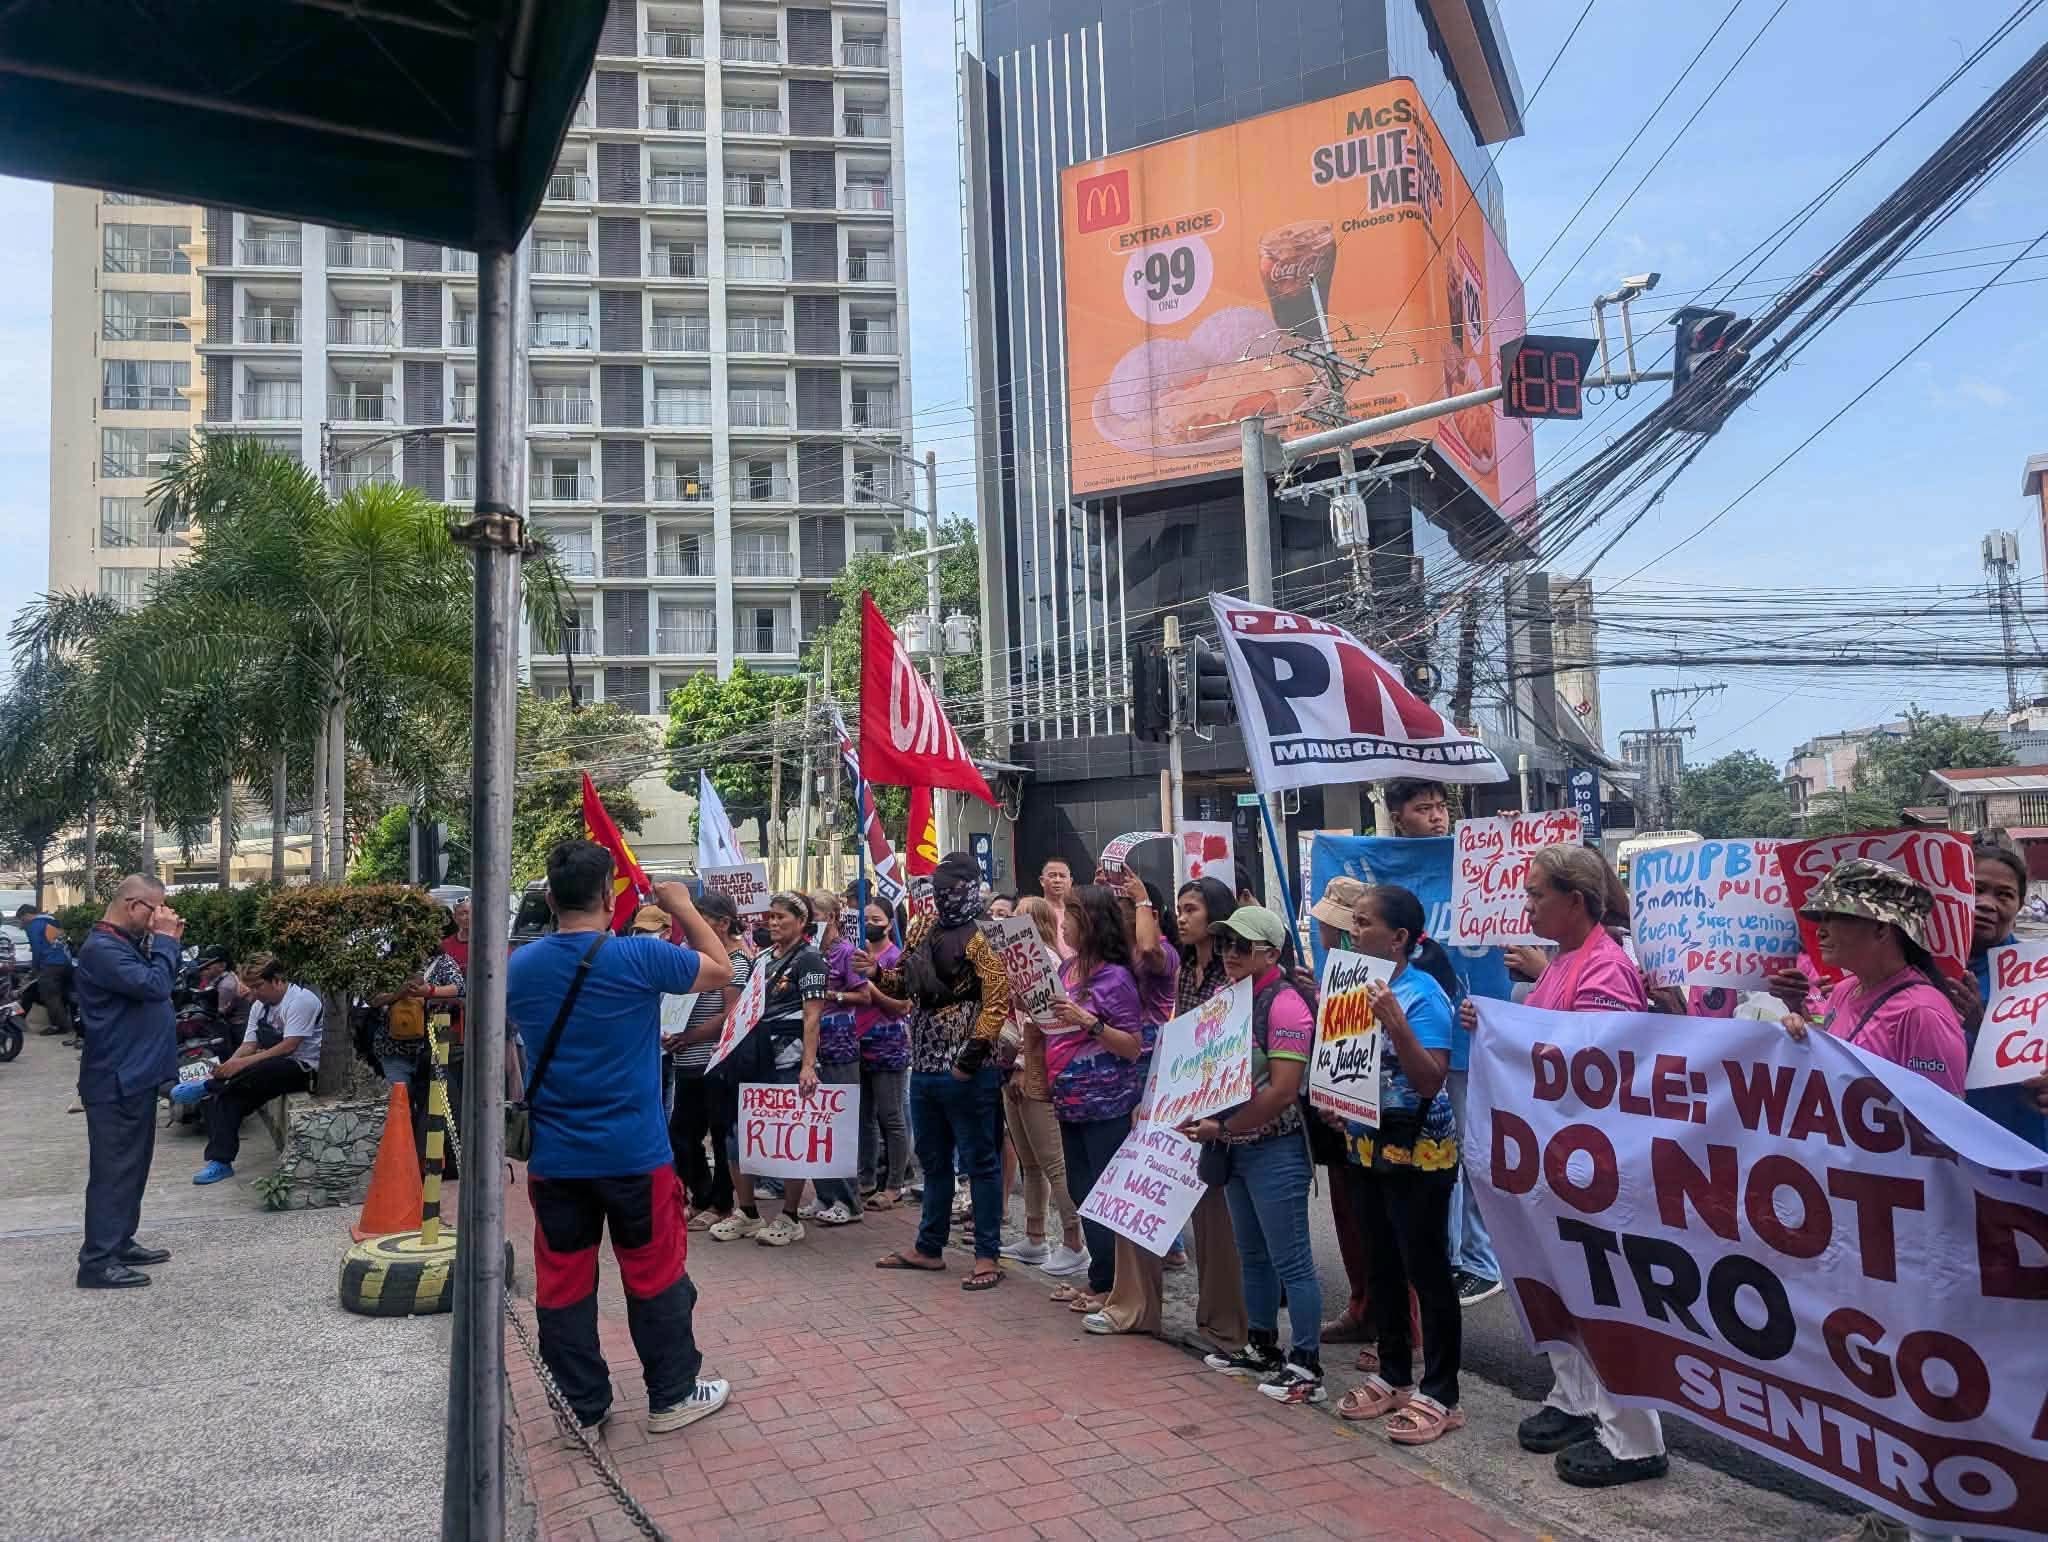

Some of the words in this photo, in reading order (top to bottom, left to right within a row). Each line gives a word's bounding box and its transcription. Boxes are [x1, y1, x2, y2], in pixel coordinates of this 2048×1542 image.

[1119, 224, 1172, 248] EXTRA
[1176, 214, 1214, 235] RICE
[1341, 214, 1394, 233] Choose
[1158, 298, 1180, 311] ONLY
[1274, 740, 1491, 762] MANGGAGAWA
[1459, 823, 1504, 860] Pasig
[1462, 856, 1484, 884] By
[1458, 906, 1533, 946] Capital
[1327, 957, 1369, 995] Nagka
[1322, 991, 1377, 1042] KAMAL
[1316, 1047, 1331, 1073] ka
[1330, 1033, 1377, 1079] Judge!
[742, 1087, 797, 1111] PASIG
[1533, 1042, 1708, 1125] DOLE:
[752, 1108, 790, 1118] COURT
[791, 1110, 808, 1121] OF
[810, 1111, 835, 1124] THE
[746, 1119, 833, 1164] RICH
[1123, 1169, 1173, 1207] WAGE
[1490, 1107, 1620, 1214] DO
[1651, 1137, 1925, 1283] NOT
[1085, 1190, 1167, 1243] INCREASE
[1556, 1216, 1798, 1362] TRO
[1822, 1307, 1991, 1424] GO
[1674, 1353, 2020, 1512] SENTRO
